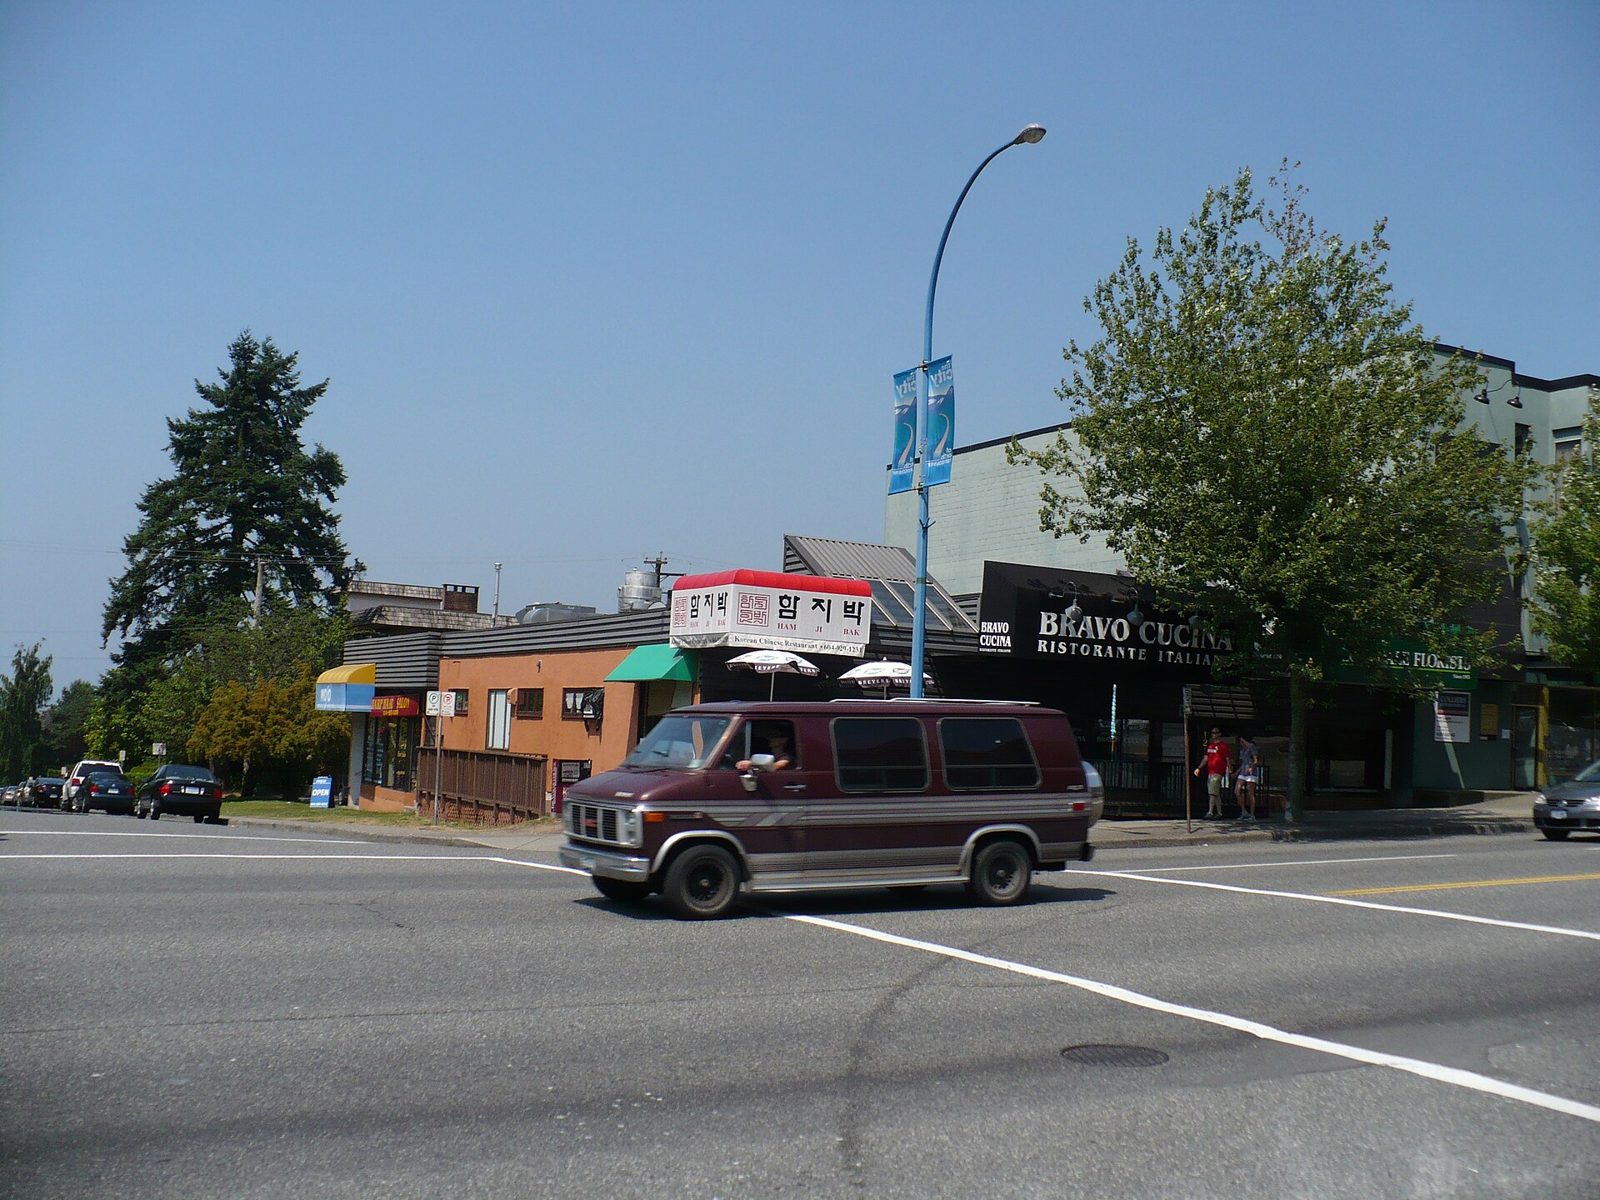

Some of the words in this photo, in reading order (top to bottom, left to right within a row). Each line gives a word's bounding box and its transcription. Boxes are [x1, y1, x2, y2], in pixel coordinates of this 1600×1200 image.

[777, 622, 797, 631] HAM
[843, 628, 861, 636] BAK
[981, 621, 1009, 634] BRAVO
[1039, 611, 1131, 642] BRAVO
[1138, 620, 1233, 651] CUCINA
[734, 635, 758, 644] Korean
[759, 638, 783, 646] Chinese
[784, 640, 818, 649] Restaurant
[979, 634, 1011, 647] CUCINA
[1037, 639, 1146, 661] RISTORANTE
[1158, 649, 1233, 668] ITALIA
[312, 789, 329, 797] OPEN
